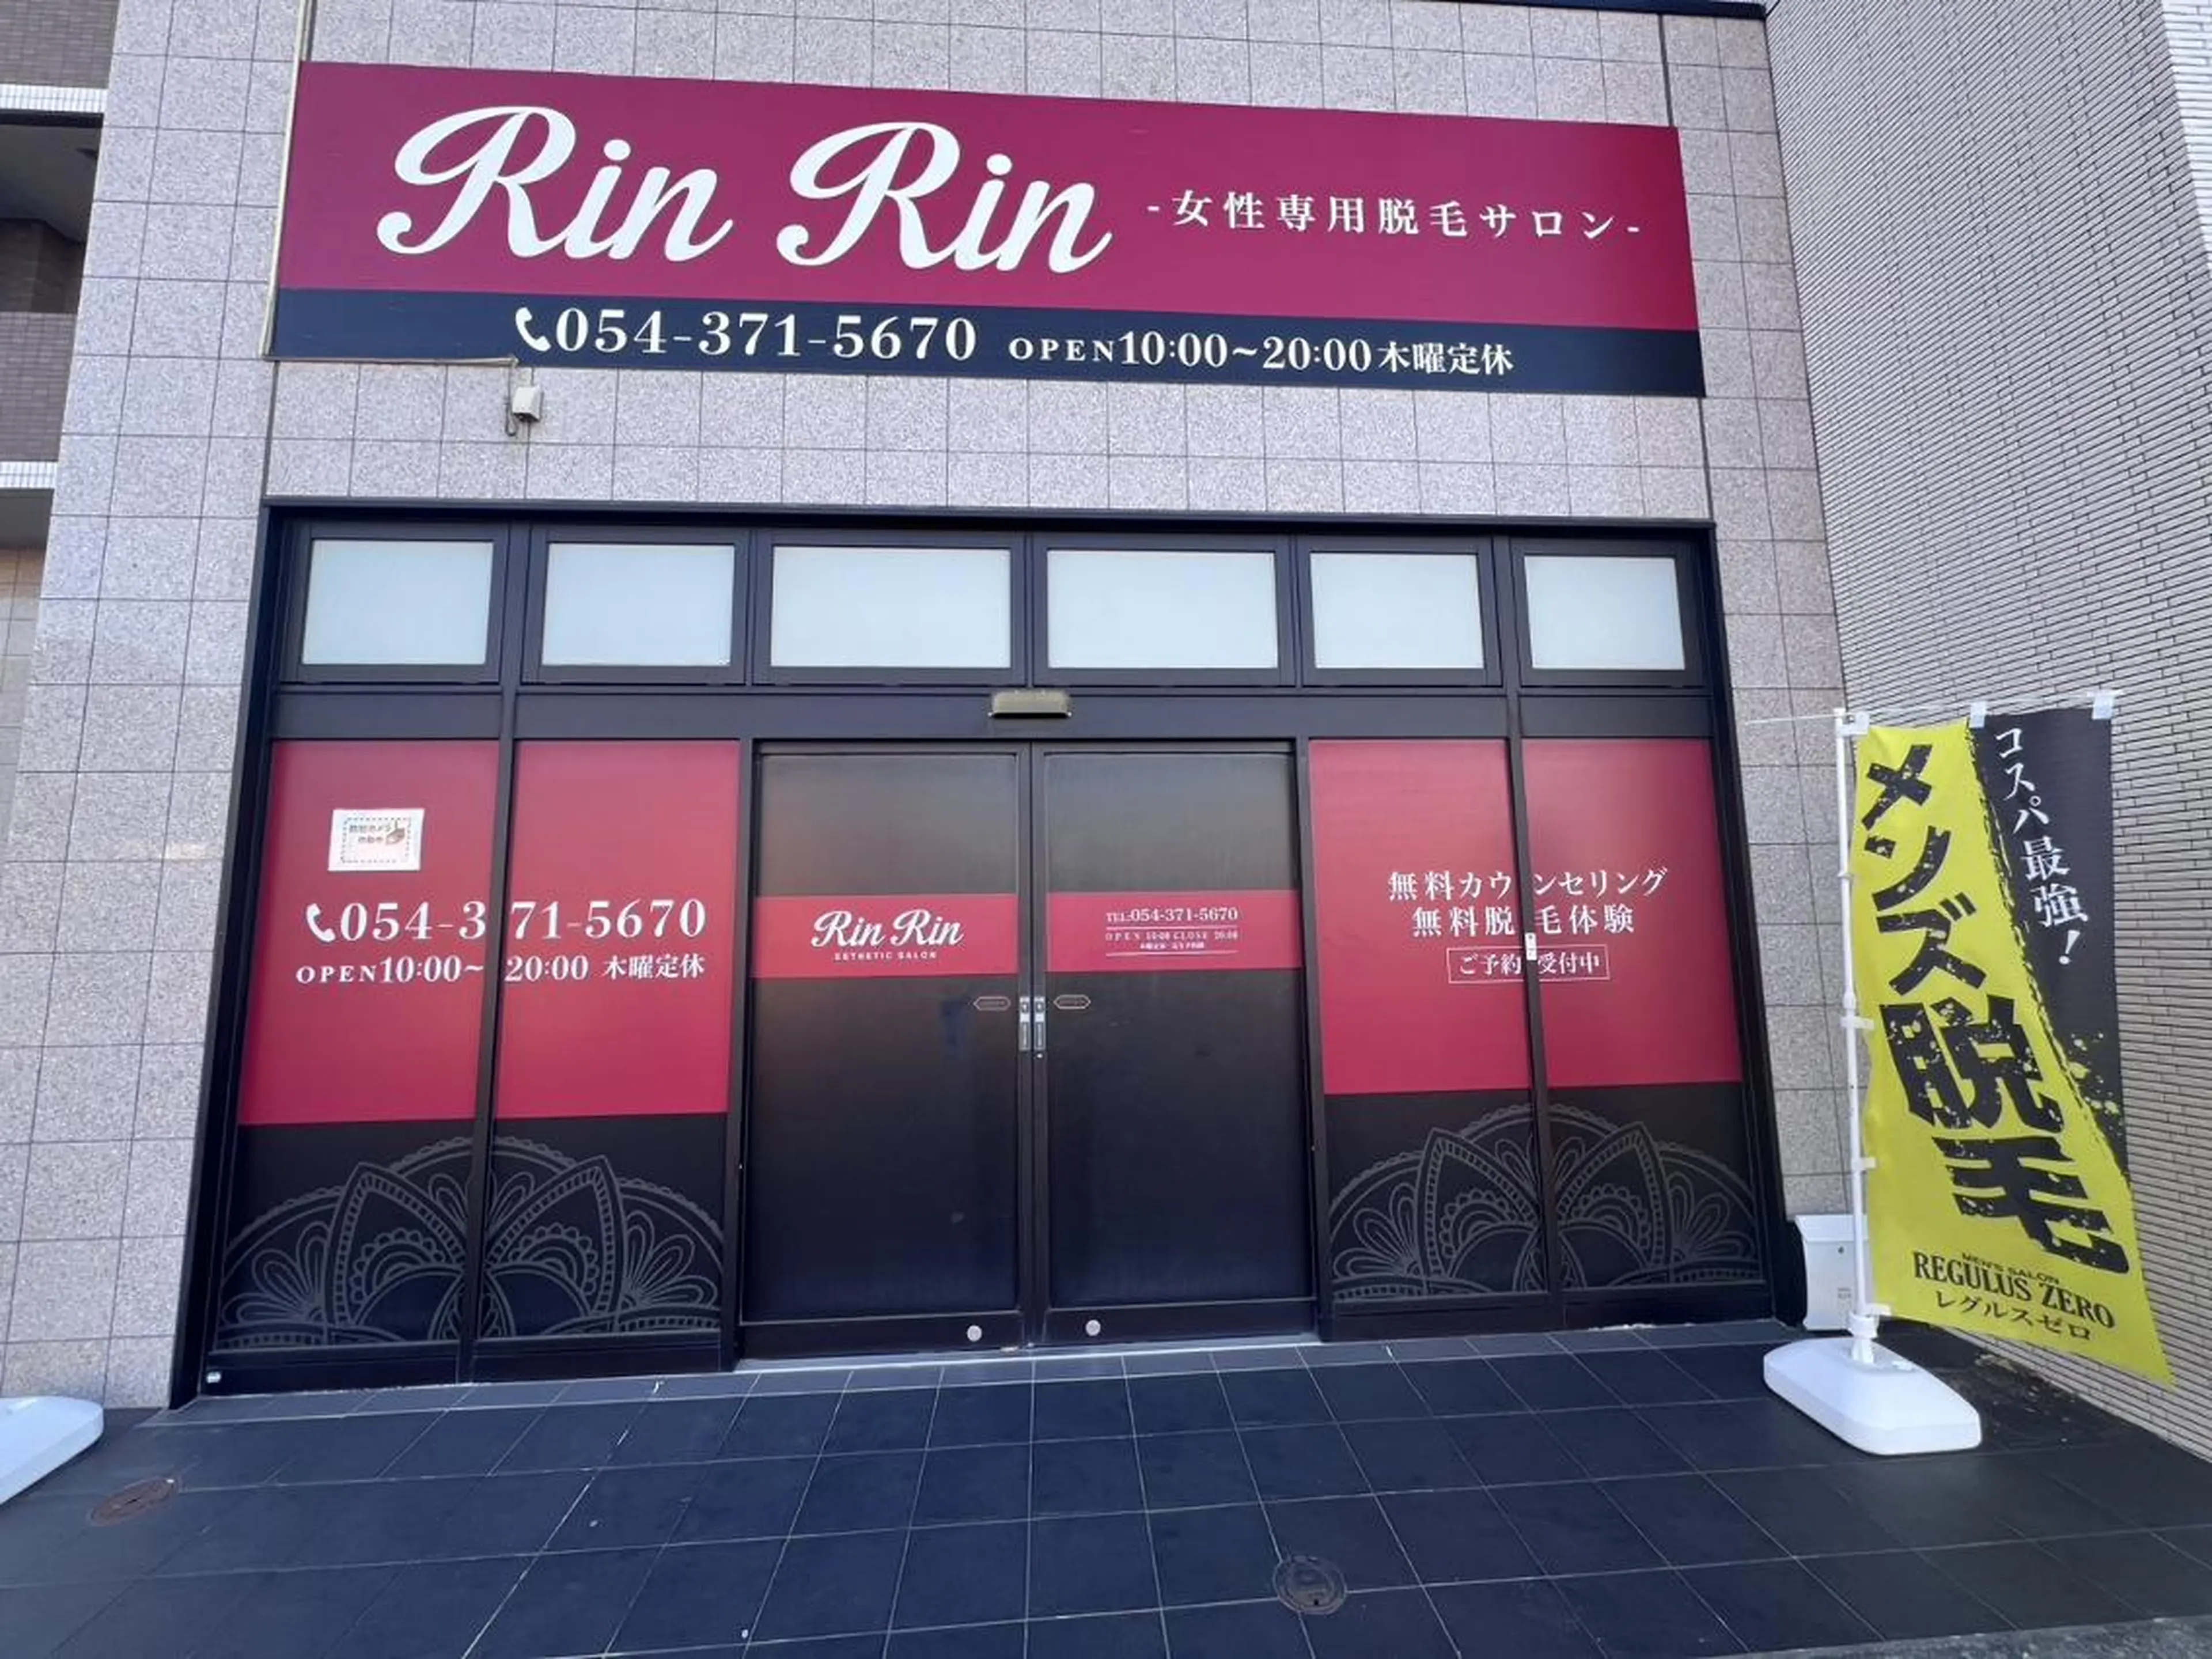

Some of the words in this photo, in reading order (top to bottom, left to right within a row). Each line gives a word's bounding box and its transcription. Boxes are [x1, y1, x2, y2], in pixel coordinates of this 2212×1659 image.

[377, 106, 734, 262] Rin
[776, 122, 1112, 273] Rin
[554, 307, 976, 370] 054-371-5670
[811, 910, 885, 946] Rin
[890, 908, 964, 946] Rin
[835, 951, 892, 961] ESTHETIC
[897, 950, 937, 960] SALON
[603, 953, 704, 979] 木曜定休
[1861, 743, 2130, 1274] メンズ脱毛
[1912, 1251, 2032, 1302] REGULUS
[2039, 1283, 2116, 1329] ZERO
